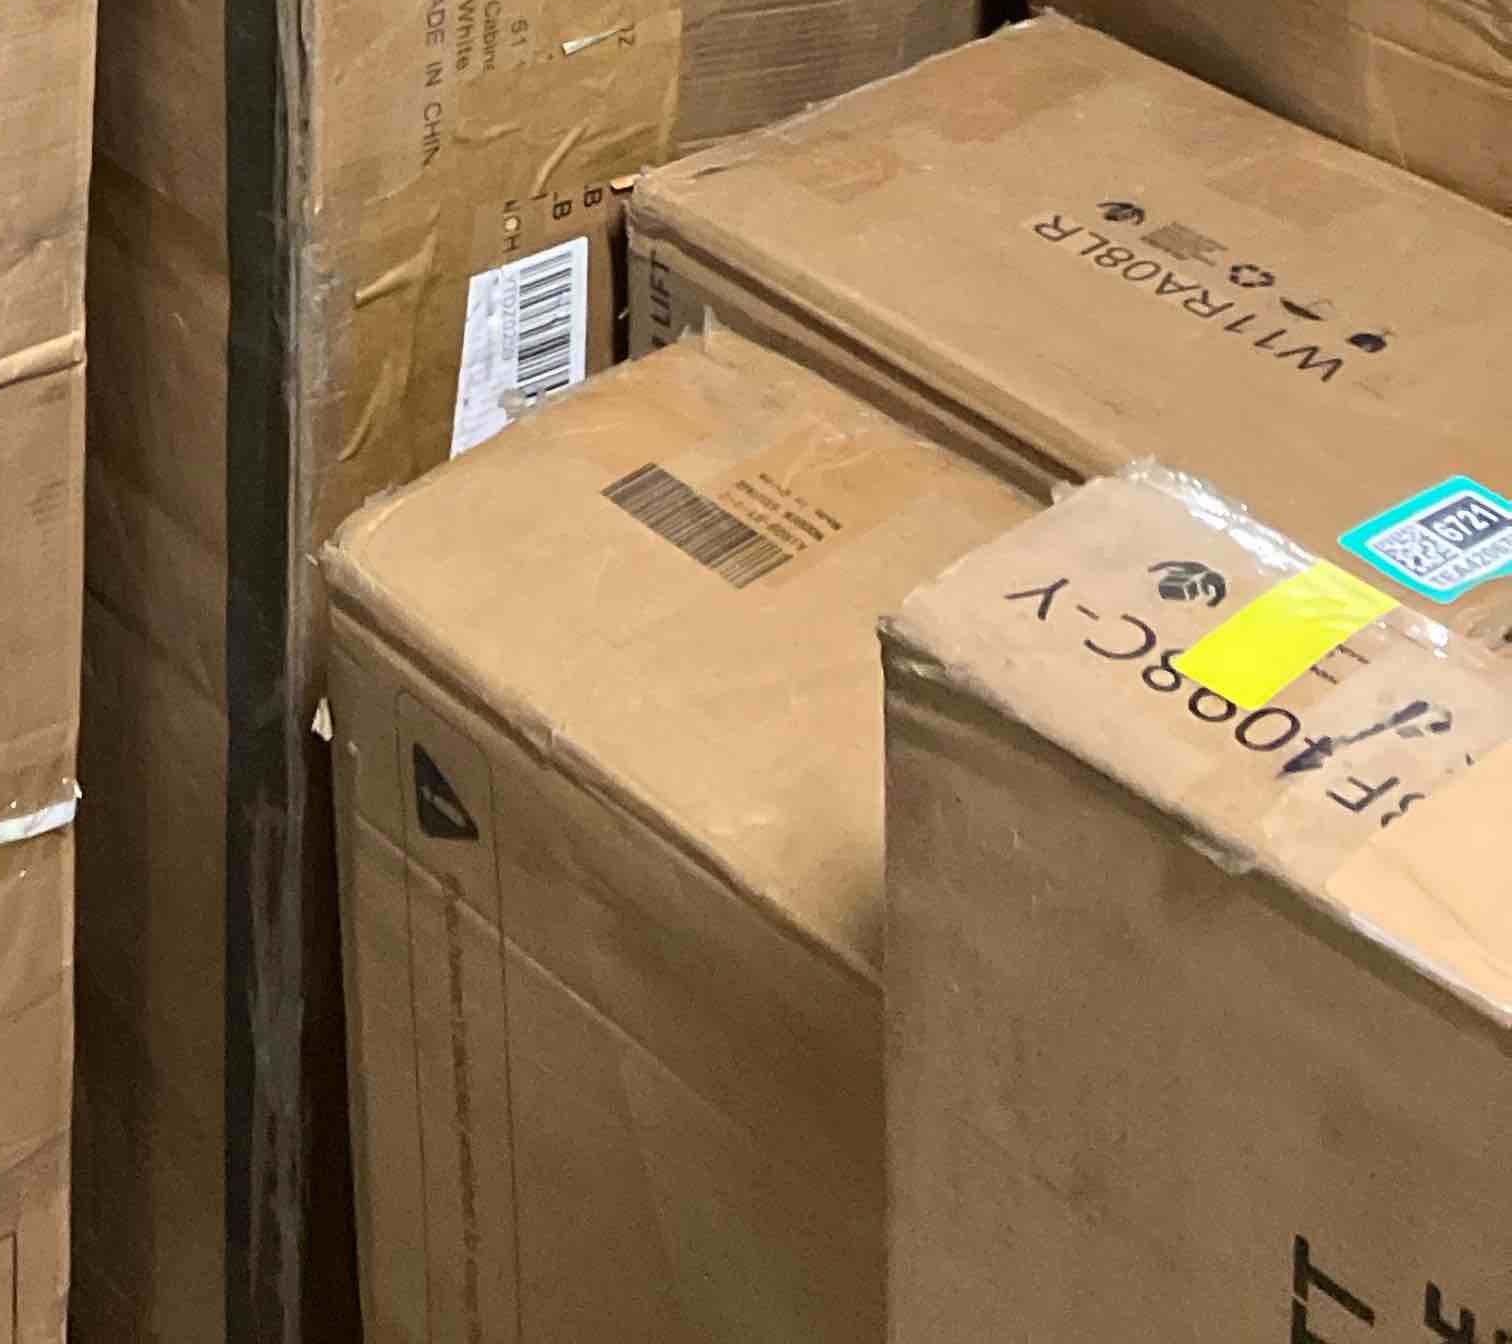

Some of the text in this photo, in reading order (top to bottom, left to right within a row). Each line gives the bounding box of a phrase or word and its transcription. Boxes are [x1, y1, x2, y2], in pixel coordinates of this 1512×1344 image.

[424, 59, 443, 89] IN
[420, 95, 444, 166] CHIN
[501, 199, 520, 254] NCH
[1033, 212, 1345, 384] W11RA08LR
[1432, 503, 1501, 543] 6721
